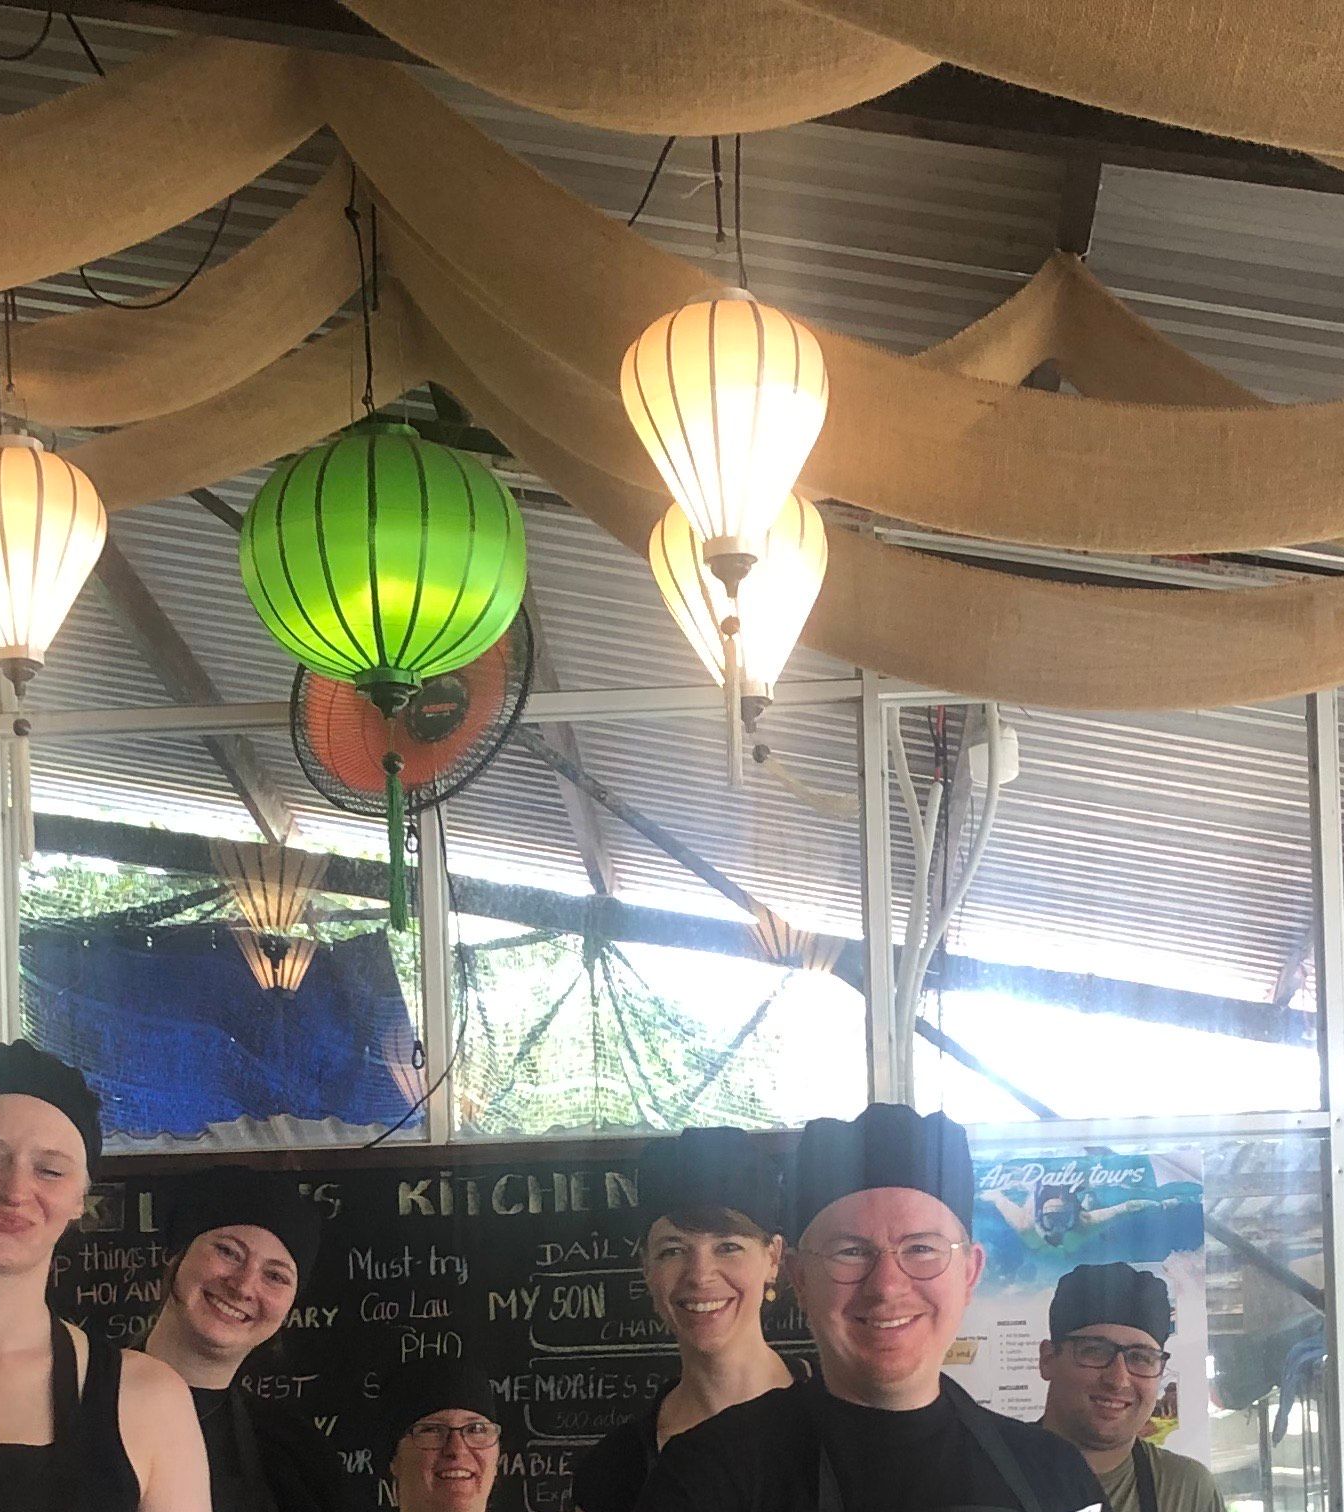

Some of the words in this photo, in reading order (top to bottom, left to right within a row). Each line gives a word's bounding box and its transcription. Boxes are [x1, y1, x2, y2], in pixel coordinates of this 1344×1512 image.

[1021, 1160, 1085, 1194] Daily
[1088, 1162, 1146, 1184] tours
[78, 1240, 146, 1283] things
[536, 1230, 642, 1266] DAILY
[76, 1282, 119, 1306] HOI
[124, 1279, 161, 1303] AN
[358, 1291, 400, 1323] Cao
[408, 1289, 451, 1319] Lau
[488, 1284, 542, 1322] MY
[548, 1280, 607, 1322] SON
